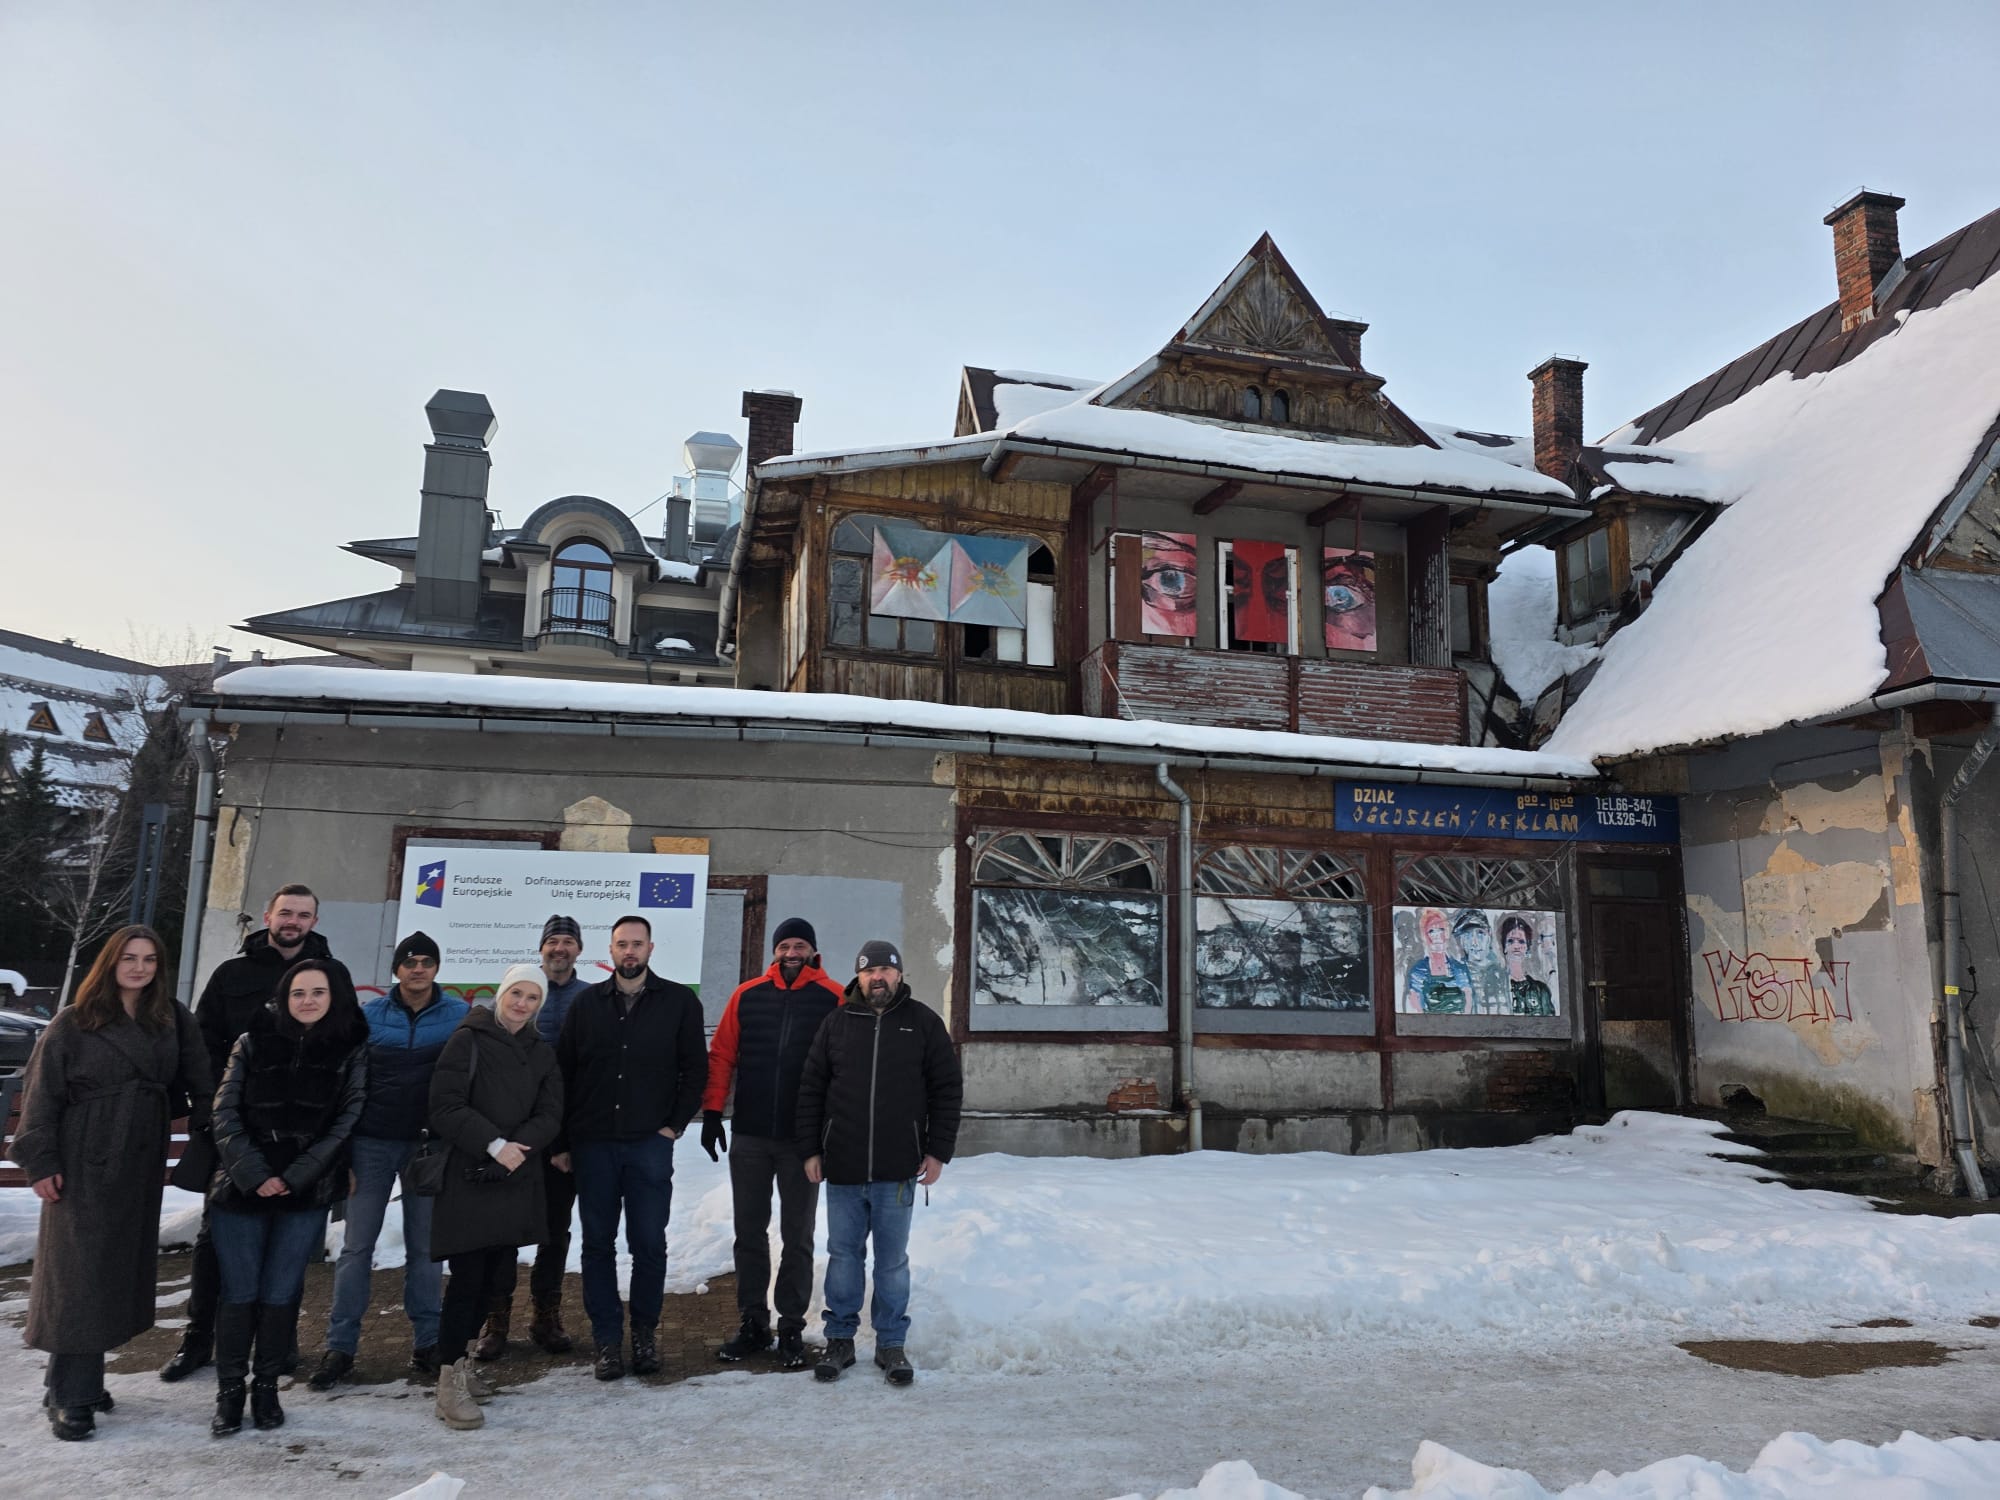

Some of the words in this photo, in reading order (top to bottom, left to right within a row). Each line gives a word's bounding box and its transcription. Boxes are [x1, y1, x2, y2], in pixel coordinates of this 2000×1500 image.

[1353, 788, 1395, 804] DZIAŁ
[1487, 812, 1579, 833] REKLAM
[453, 875, 503, 885] Fundusze
[525, 876, 602, 887] Dofinansowane
[604, 879, 631, 889] przez
[452, 887, 513, 898] Europejskie
[551, 889, 573, 899] Unię
[576, 890, 631, 901] Europejską
[474, 957, 499, 965] Tytusa
